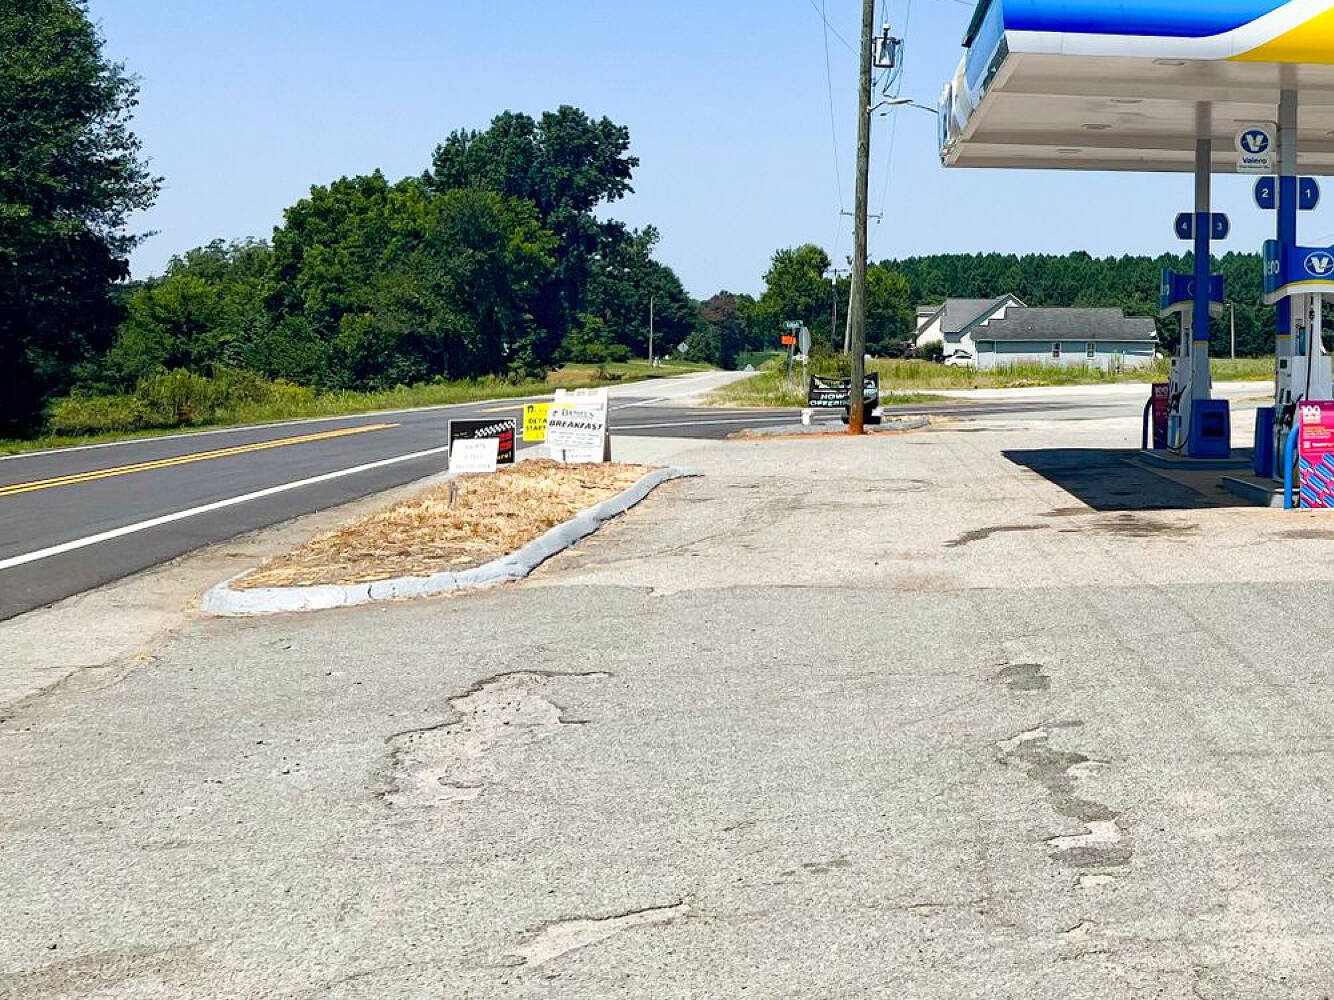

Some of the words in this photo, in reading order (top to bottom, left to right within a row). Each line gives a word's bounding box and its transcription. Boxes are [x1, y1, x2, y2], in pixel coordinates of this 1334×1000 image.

[1242, 156, 1269, 164] Valero
[1262, 188, 1269, 198] 2
[1305, 188, 1311, 199] 1
[1181, 222, 1188, 230] 4
[549, 420, 603, 430] BREAKFAST
